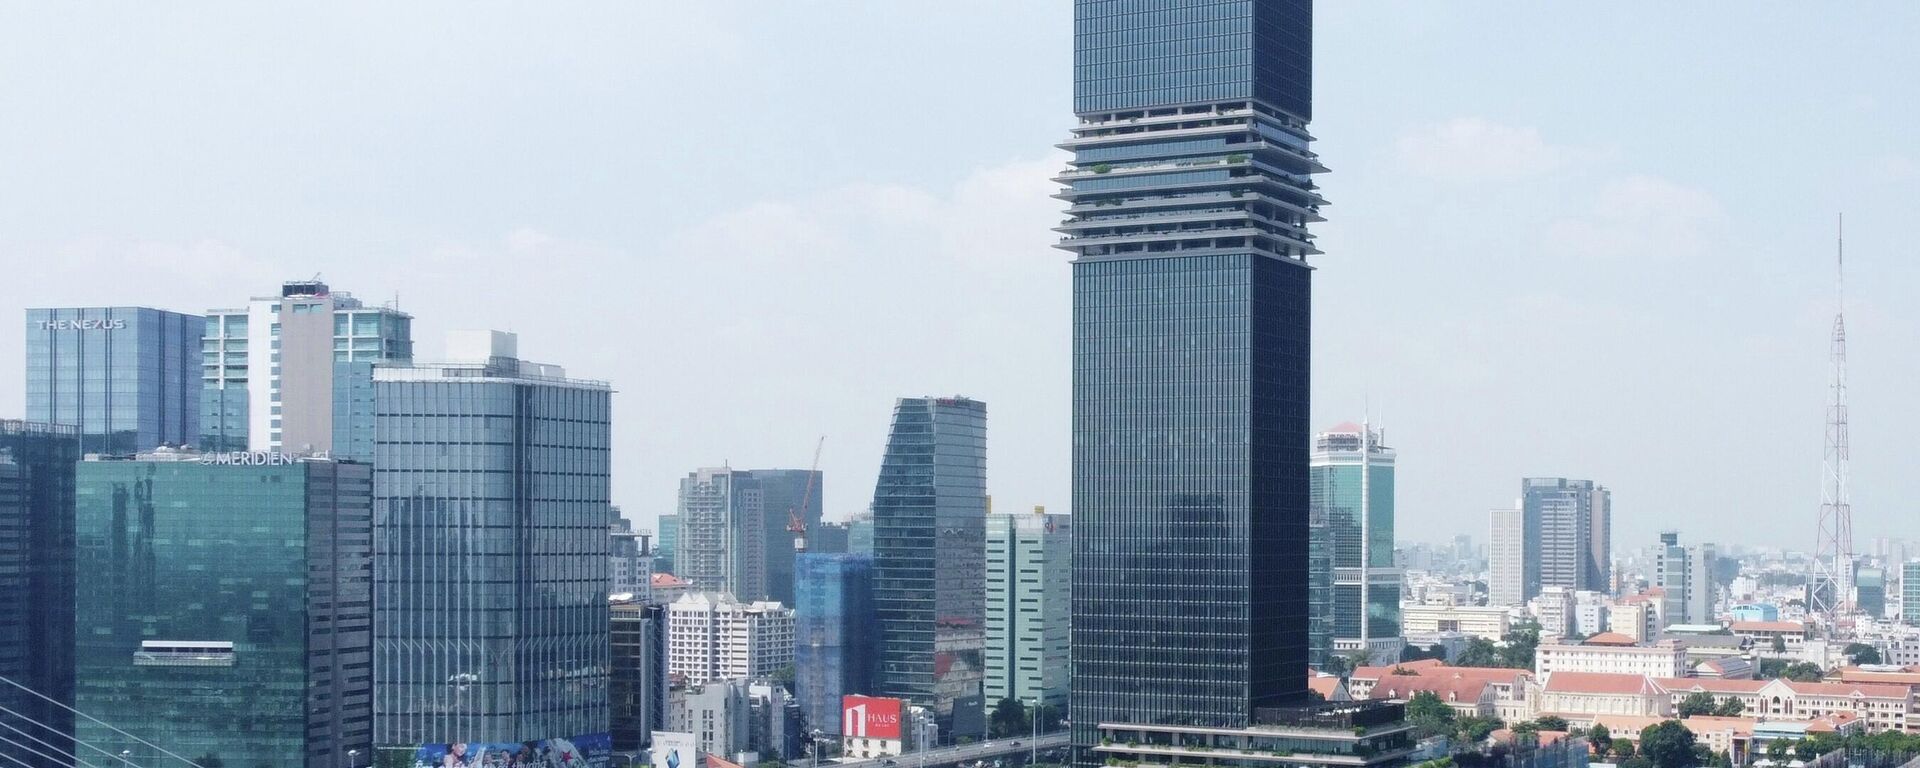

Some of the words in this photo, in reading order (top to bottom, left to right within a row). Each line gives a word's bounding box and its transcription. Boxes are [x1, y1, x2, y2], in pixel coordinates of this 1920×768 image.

[36, 319, 67, 330] THE
[70, 319, 127, 330] NEXUS
[216, 451, 293, 466] MERIDIEN
[867, 713, 897, 724] HAUS
